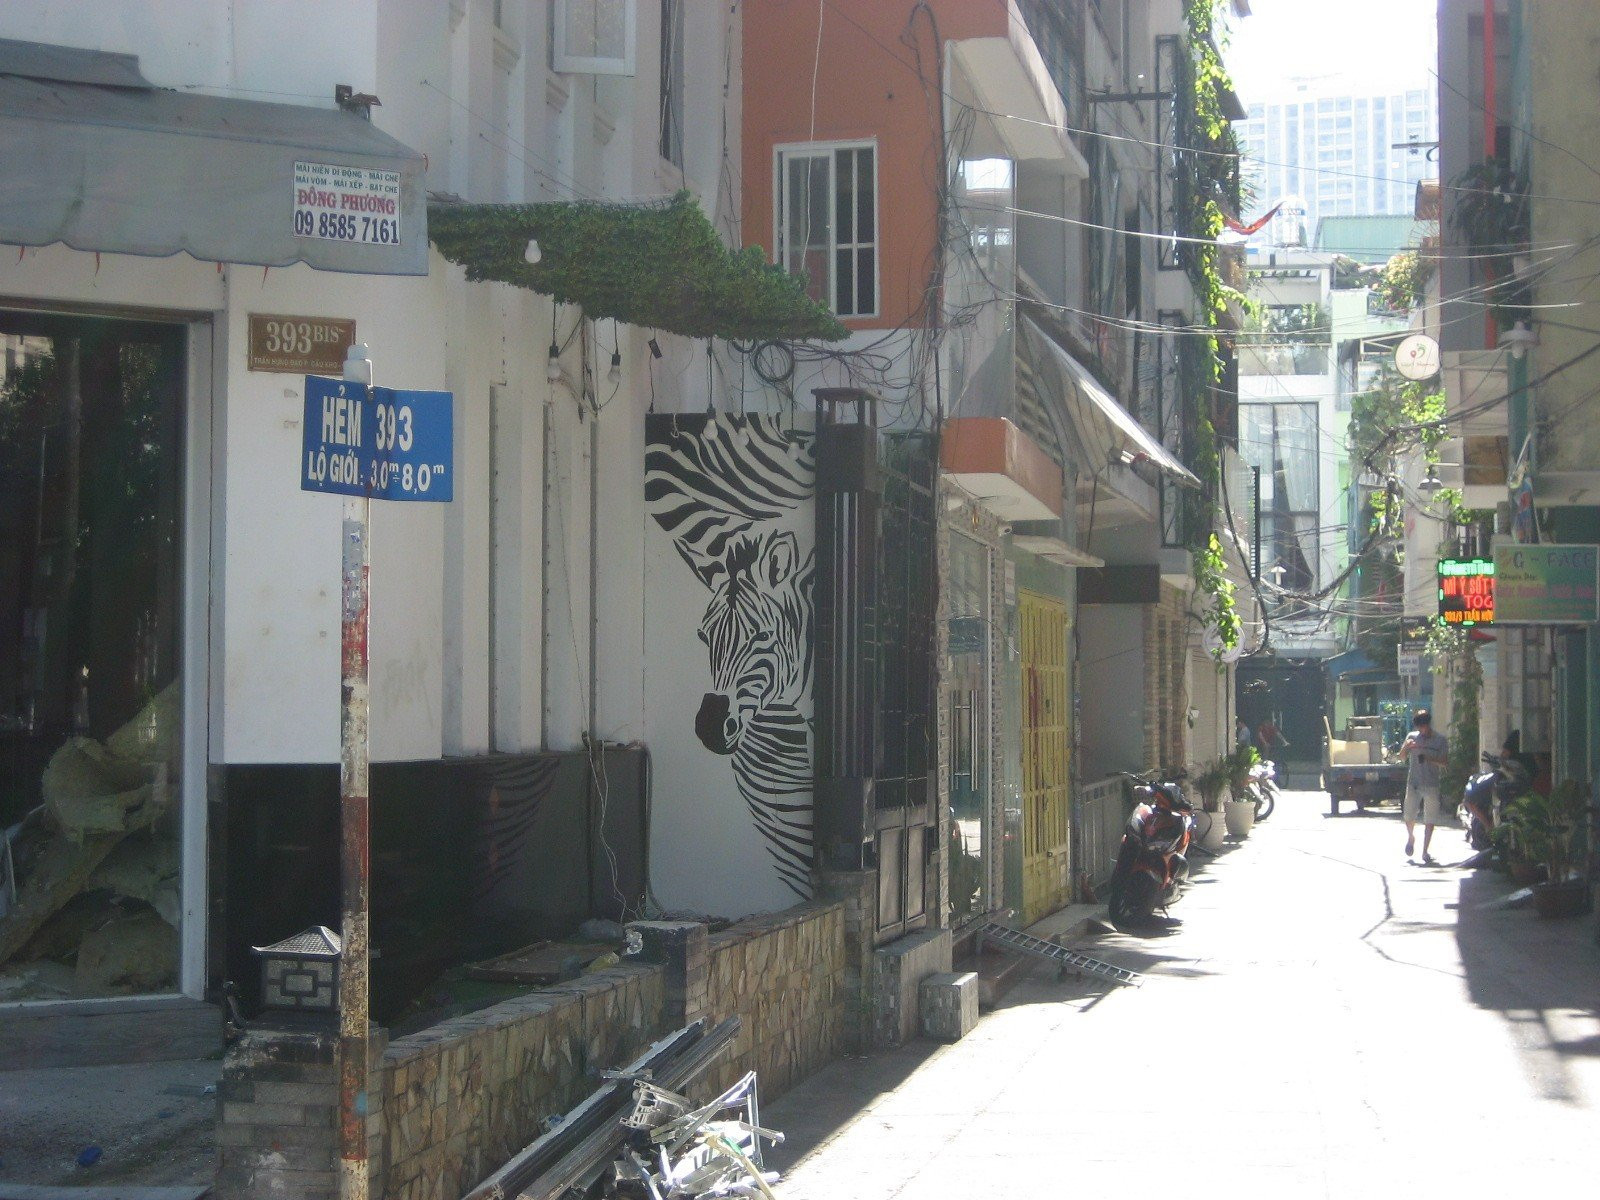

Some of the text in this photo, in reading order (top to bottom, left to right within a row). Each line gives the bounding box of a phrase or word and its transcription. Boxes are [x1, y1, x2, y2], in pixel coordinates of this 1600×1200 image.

[294, 209, 399, 244] 09 8585 7161
[322, 384, 414, 452] HẺM 393
[307, 445, 327, 487] LỘ
